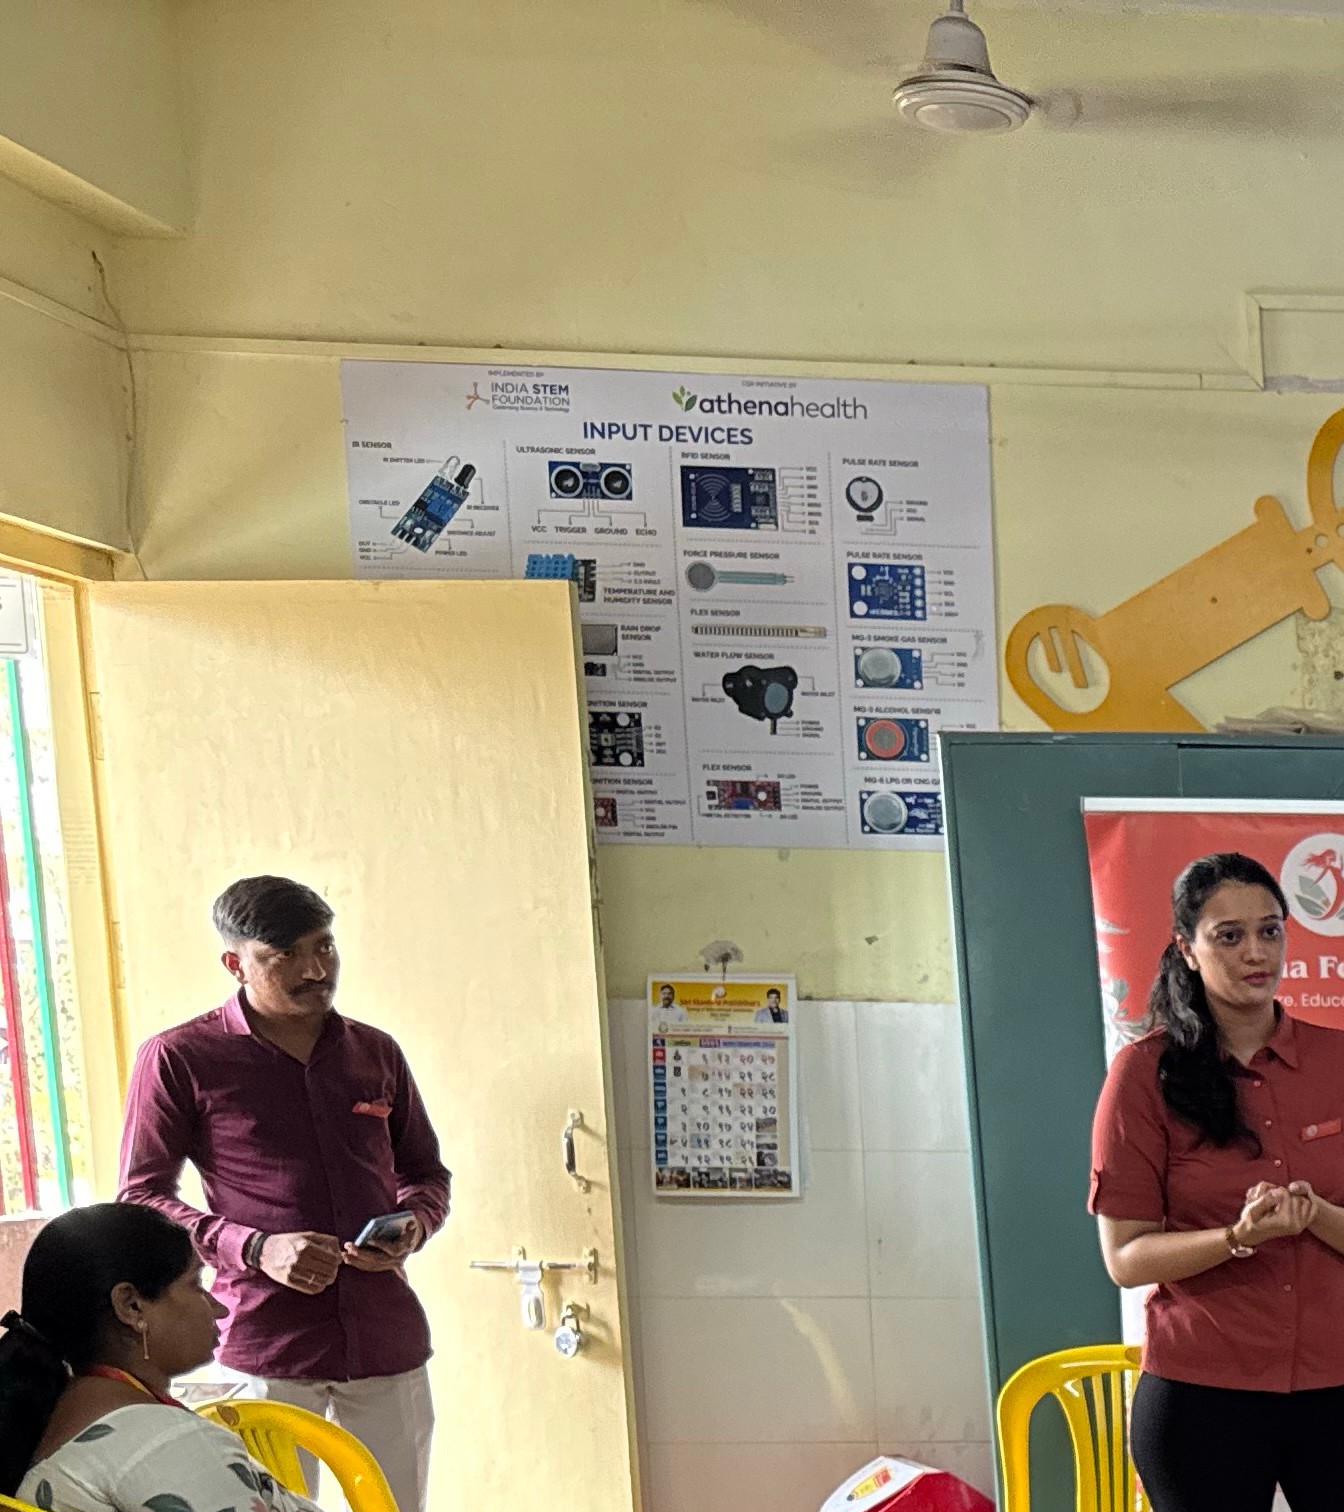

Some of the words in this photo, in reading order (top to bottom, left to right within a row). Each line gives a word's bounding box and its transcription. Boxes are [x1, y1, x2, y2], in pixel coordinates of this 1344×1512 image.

[491, 382, 527, 394] INDIA
[532, 384, 569, 395] STEM
[492, 394, 570, 406] FOUNDATION
[699, 392, 868, 419] athenahealth
[583, 421, 652, 441] INPUT
[658, 425, 754, 445] DEVICES
[516, 446, 564, 454] ULTRASONIC
[565, 447, 596, 455] SENSOR
[700, 453, 730, 461] SENSOR
[842, 457, 866, 466] PULSE
[888, 459, 919, 468] SENSOR
[683, 550, 708, 558] FORCE
[749, 552, 779, 560] SENSOR
[603, 588, 657, 596] TEMPERATURE
[659, 589, 675, 597] AND
[642, 597, 672, 605] SENSOR
[710, 609, 741, 617] SENSOR
[621, 633, 651, 641] SENSOR
[744, 652, 774, 660] SENSOR
